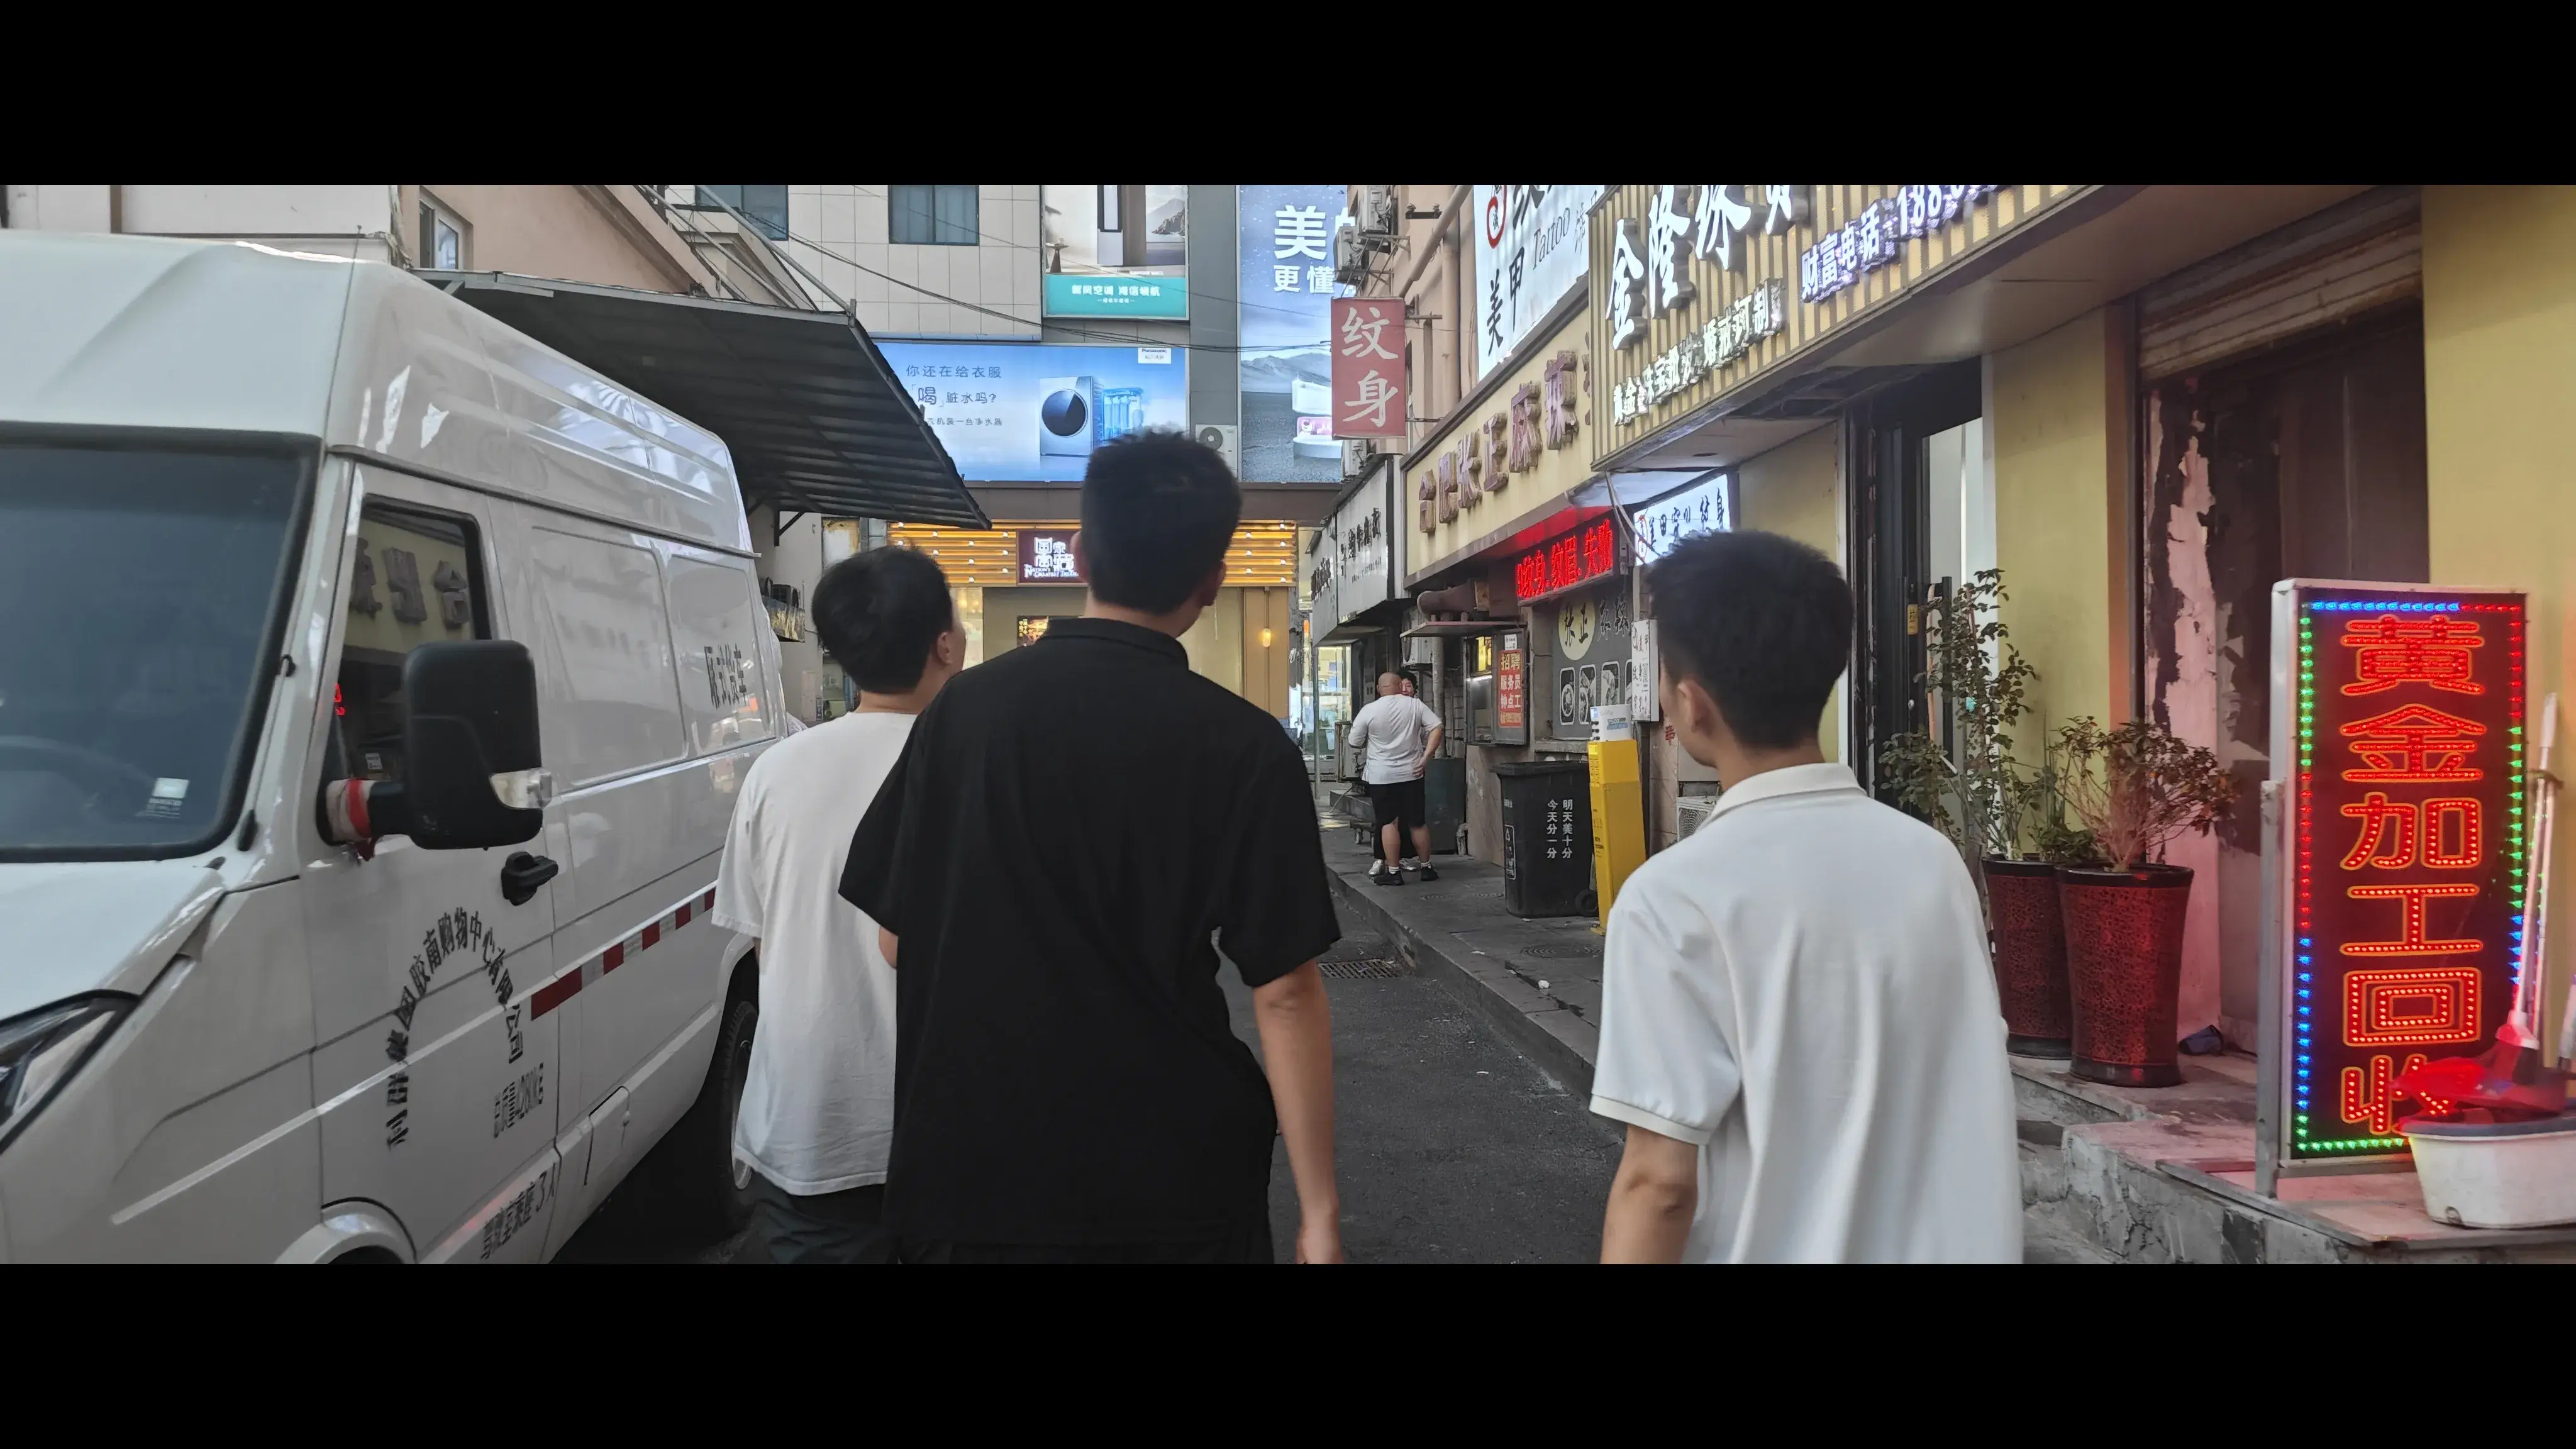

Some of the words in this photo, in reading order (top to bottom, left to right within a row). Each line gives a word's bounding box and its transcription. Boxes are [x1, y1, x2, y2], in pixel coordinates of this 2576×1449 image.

[1533, 208, 1570, 270] Tattoo
[1273, 265, 1356, 297] 更懂
[1487, 247, 1524, 356] 美甲
[906, 365, 1002, 379] 你还在给衣服
[1341, 307, 1399, 427] 纹身
[1500, 674, 1521, 690] 服务员
[1501, 652, 1520, 670] 招聘
[1500, 694, 1521, 709] 钟点工
[1546, 799, 1558, 859] 今天分一分
[1562, 799, 1574, 859] 明天美十分
[2340, 614, 2487, 1137] 黄金加工回收
